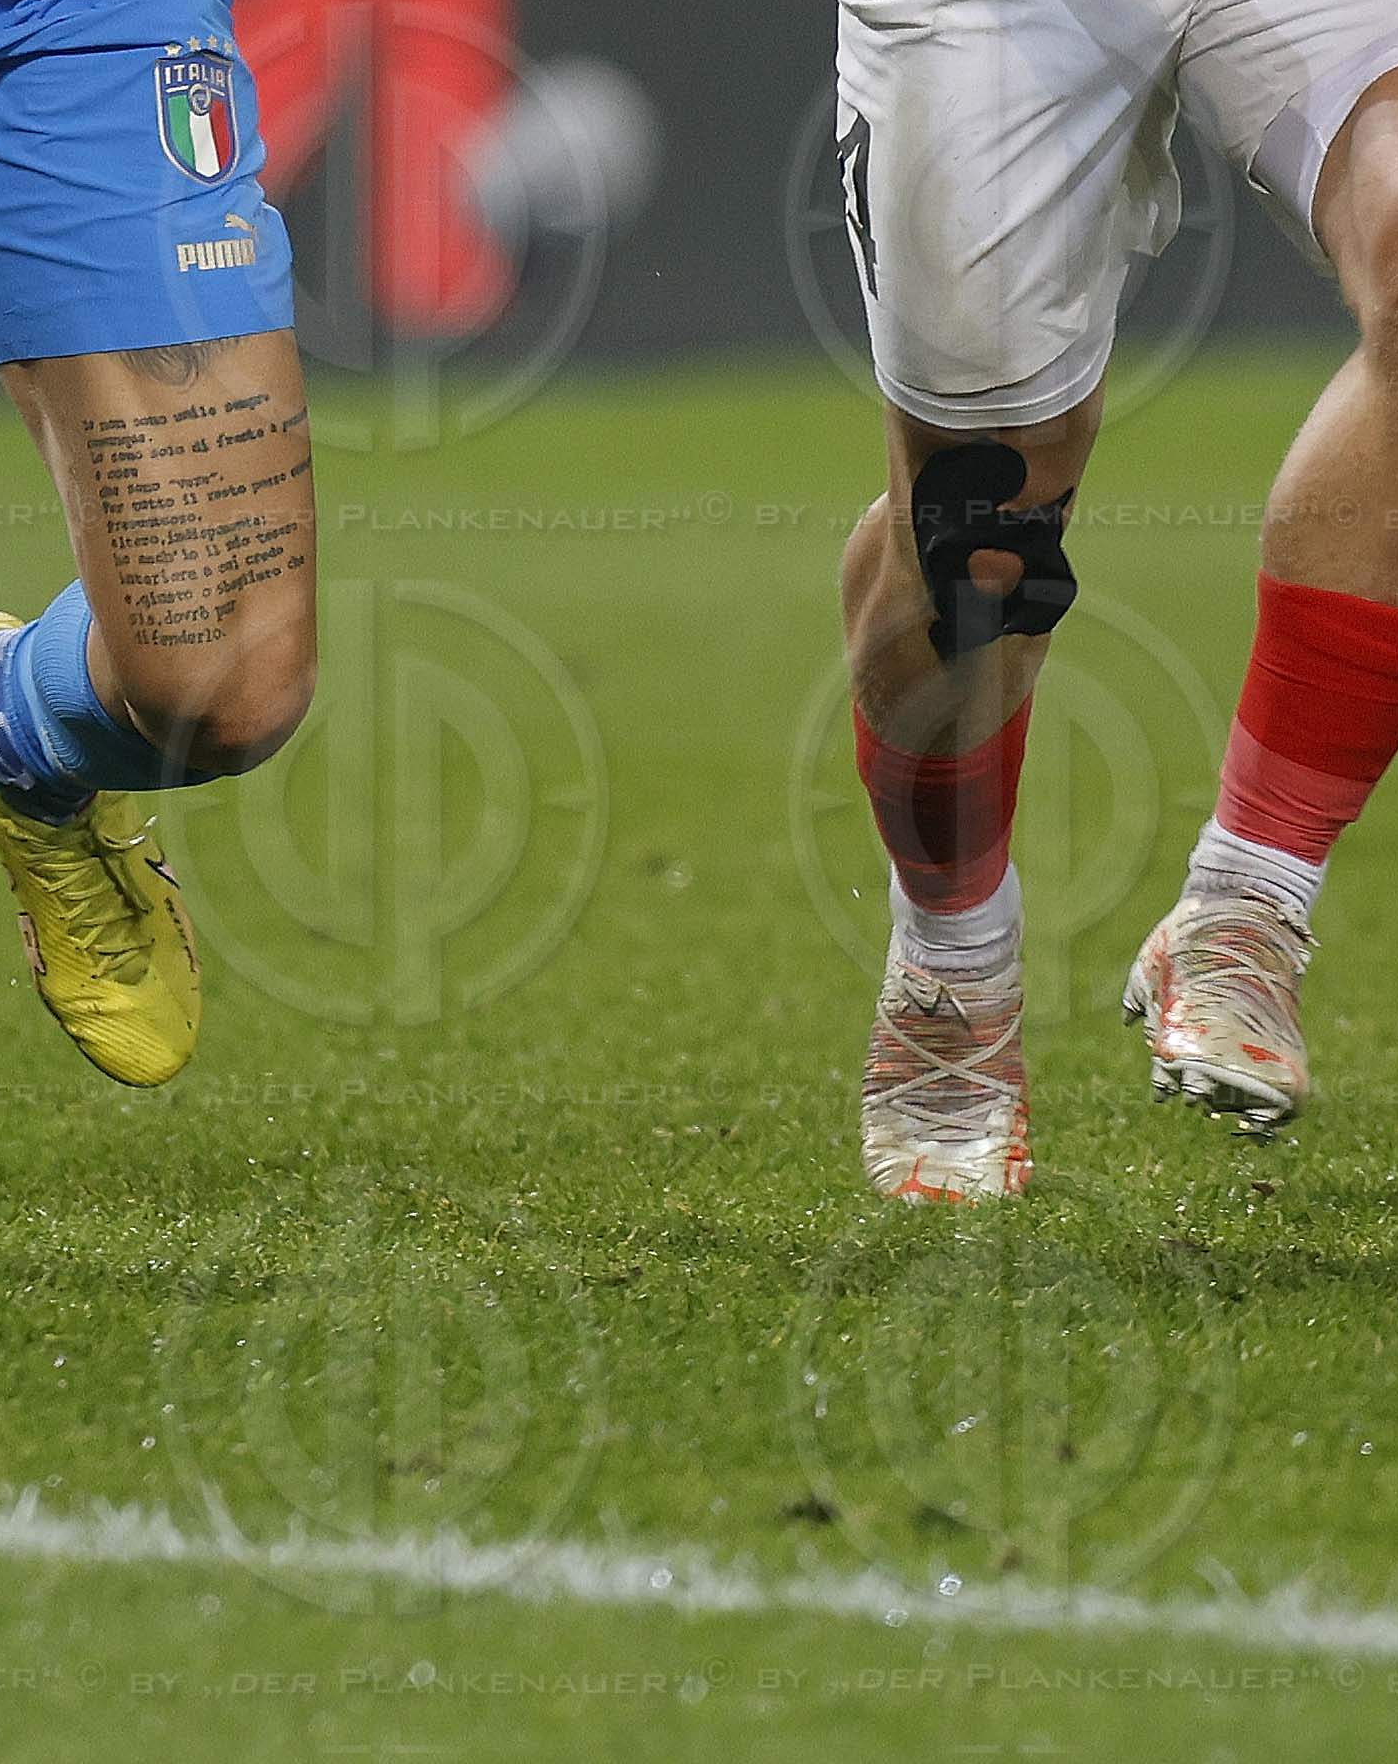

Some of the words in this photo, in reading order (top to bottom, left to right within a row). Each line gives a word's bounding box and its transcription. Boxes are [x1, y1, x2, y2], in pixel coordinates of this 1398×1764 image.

[165, 63, 225, 88] ITALIA
[192, 438, 209, 453] di
[205, 543, 221, 557] il
